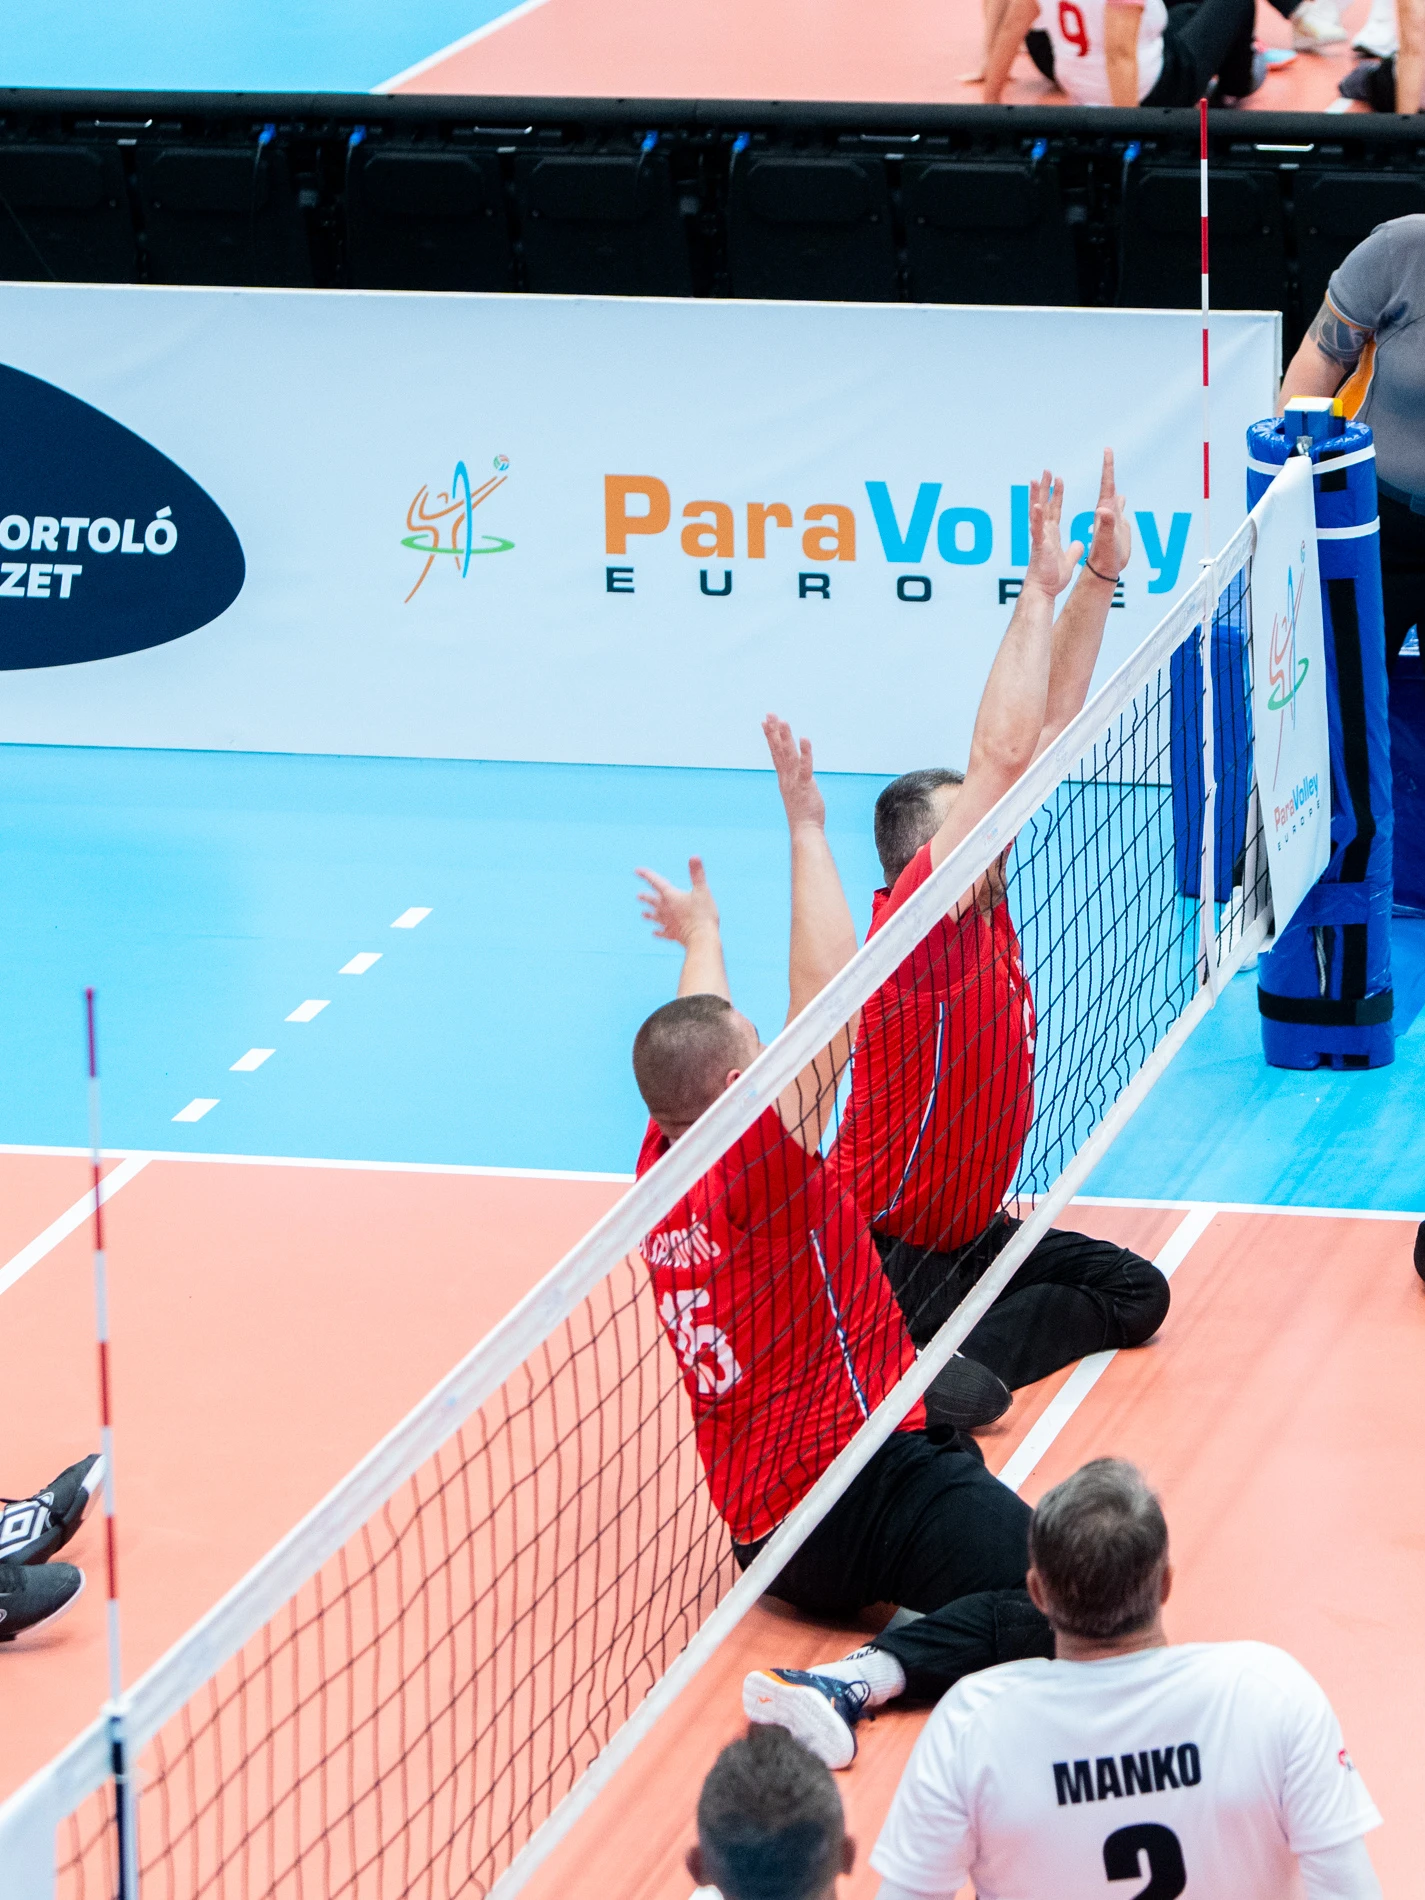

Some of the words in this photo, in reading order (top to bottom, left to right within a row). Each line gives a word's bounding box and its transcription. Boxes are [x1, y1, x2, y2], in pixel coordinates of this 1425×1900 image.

[1059, 0, 1088, 57] 9
[0, 506, 178, 556] ORTOLÓ
[604, 474, 1193, 594] ParaVoly
[0, 562, 83, 599] ZET
[1274, 772, 1319, 833] ParaVolley
[1277, 799, 1321, 852] EUROPE
[1052, 1742, 1202, 1807] MANKO
